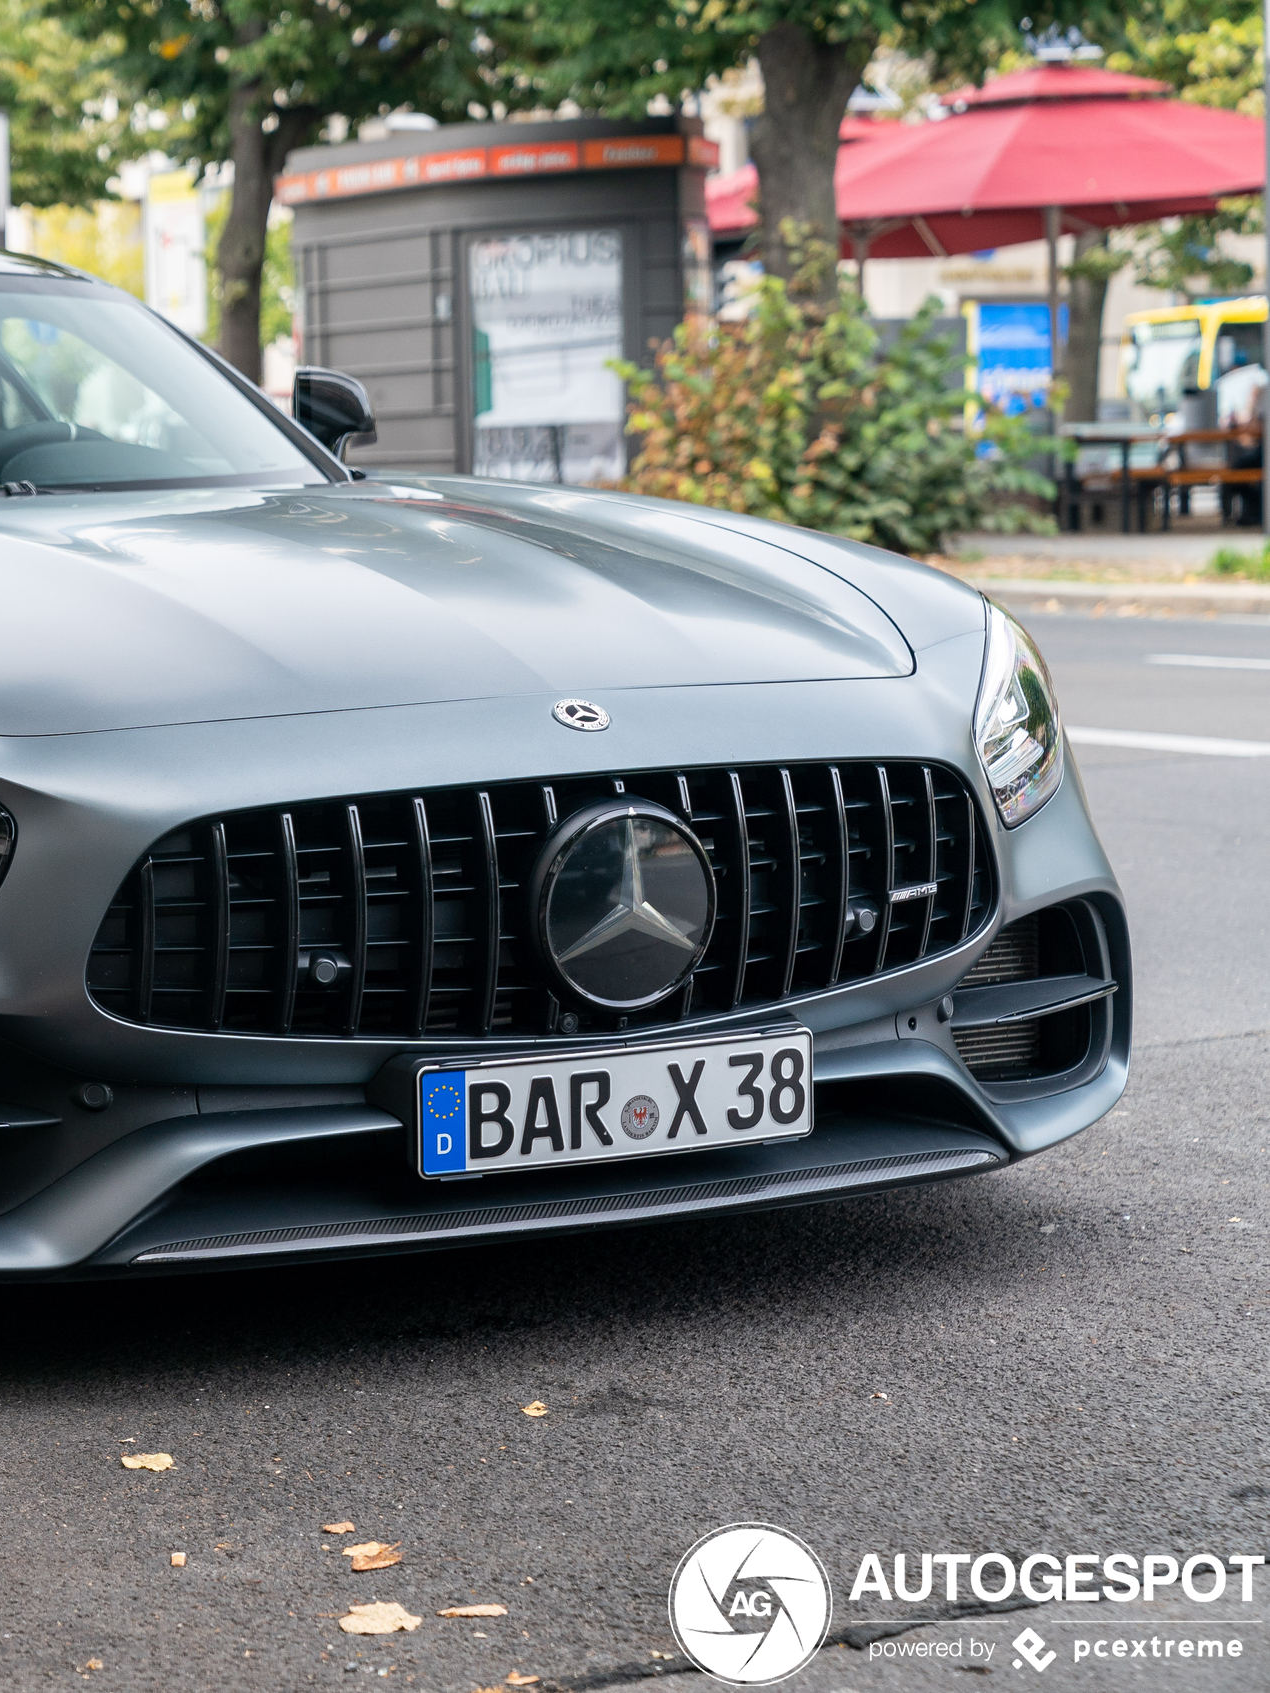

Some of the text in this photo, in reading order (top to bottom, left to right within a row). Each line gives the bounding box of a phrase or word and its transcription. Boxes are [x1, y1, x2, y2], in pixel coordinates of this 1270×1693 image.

[905, 884, 937, 899] AMG
[437, 1048, 805, 1159] D BAR X 38
